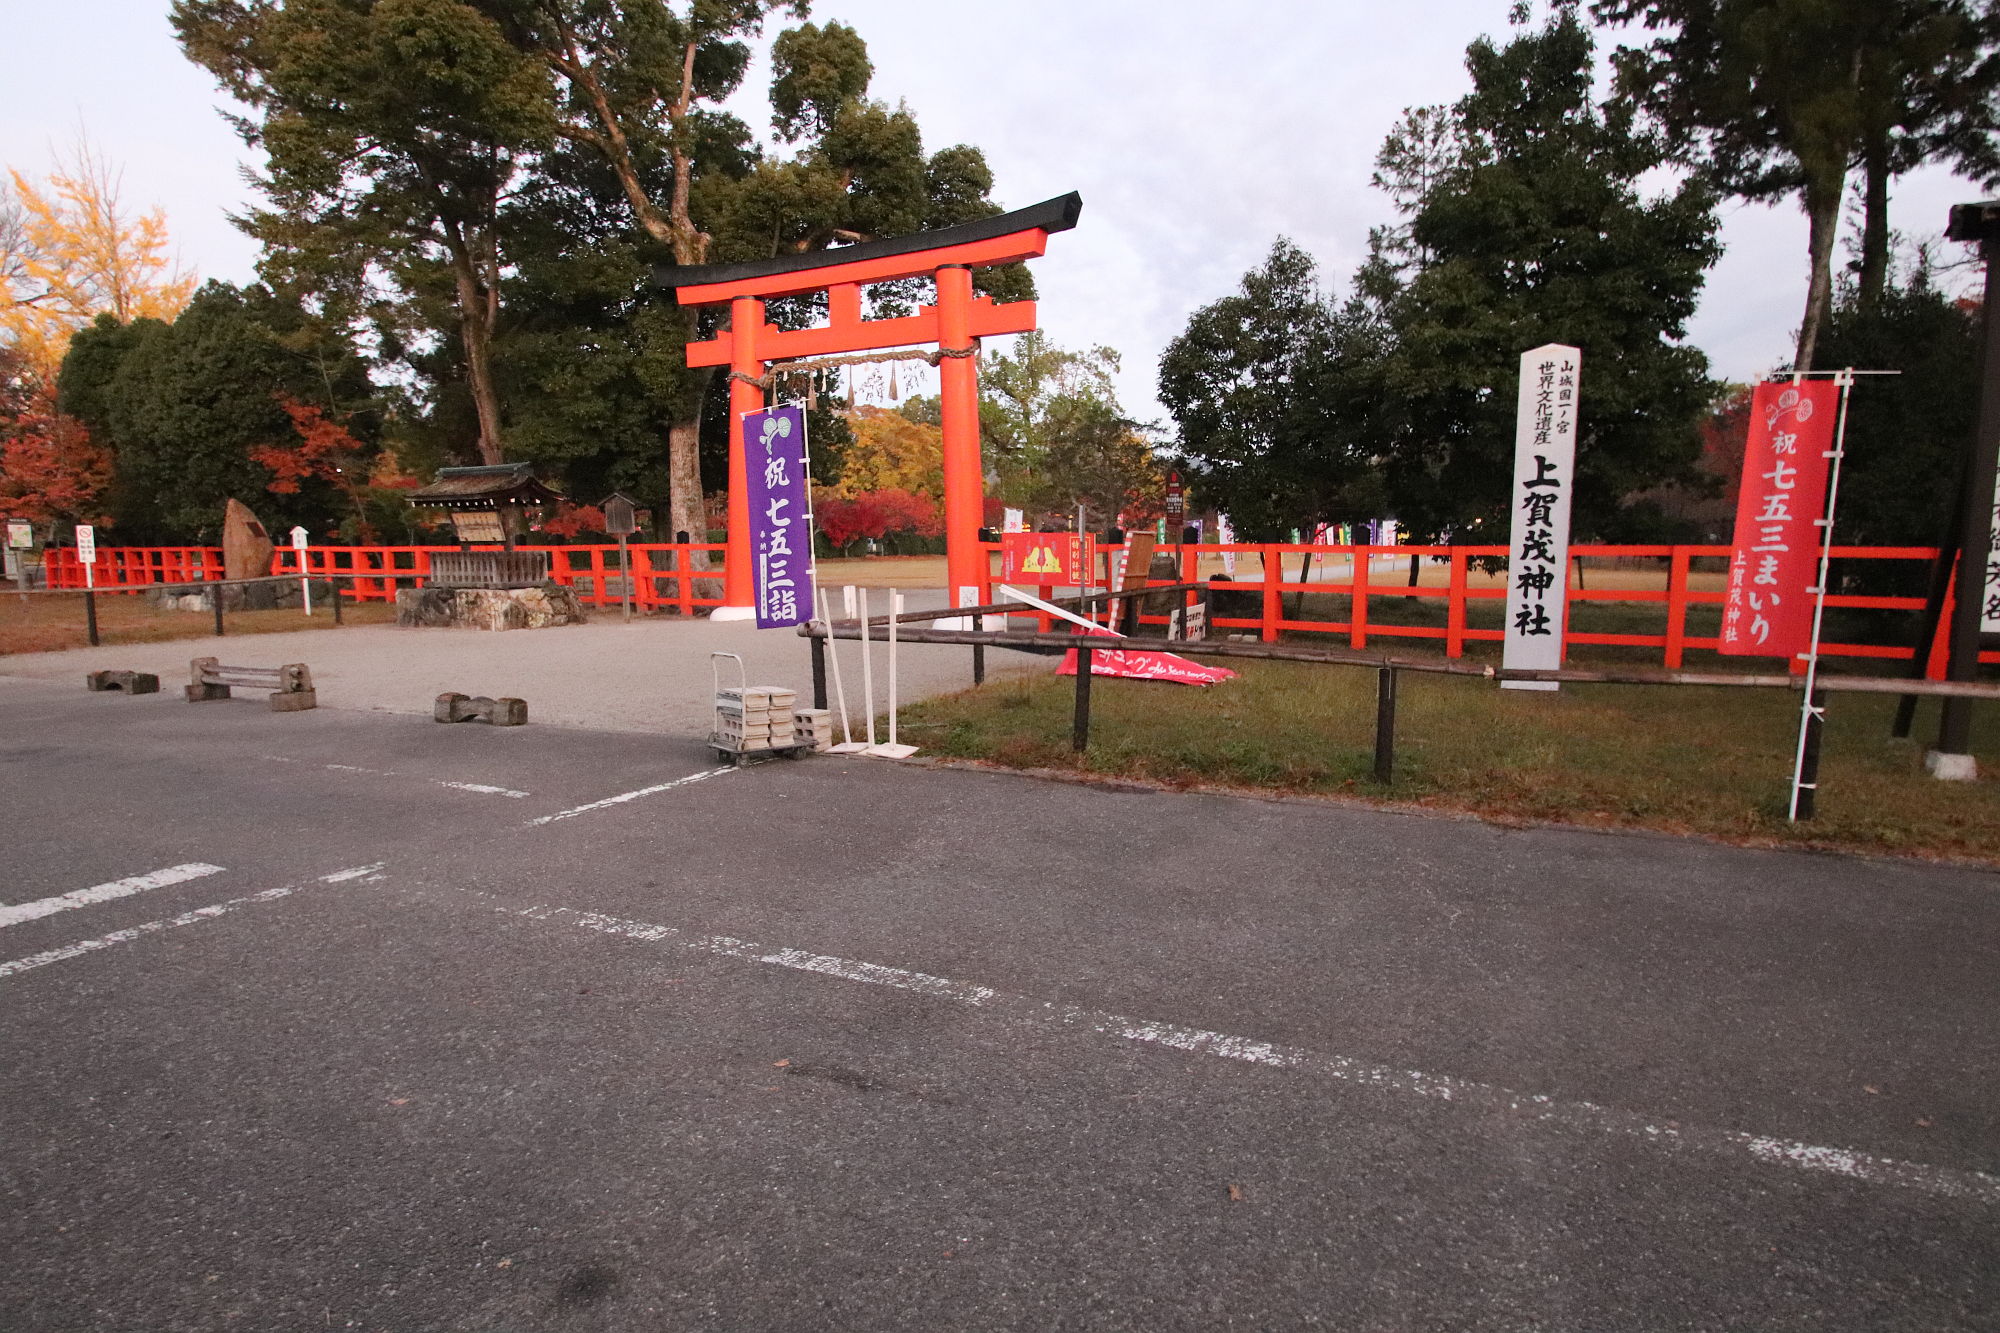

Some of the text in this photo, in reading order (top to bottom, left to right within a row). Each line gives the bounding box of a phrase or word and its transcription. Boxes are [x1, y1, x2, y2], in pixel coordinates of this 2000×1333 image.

[1533, 361, 1556, 446] 世界文化遺産
[1513, 454, 1561, 637] 上賀茂神社
[1724, 550, 1748, 644] 上賀茂神社
